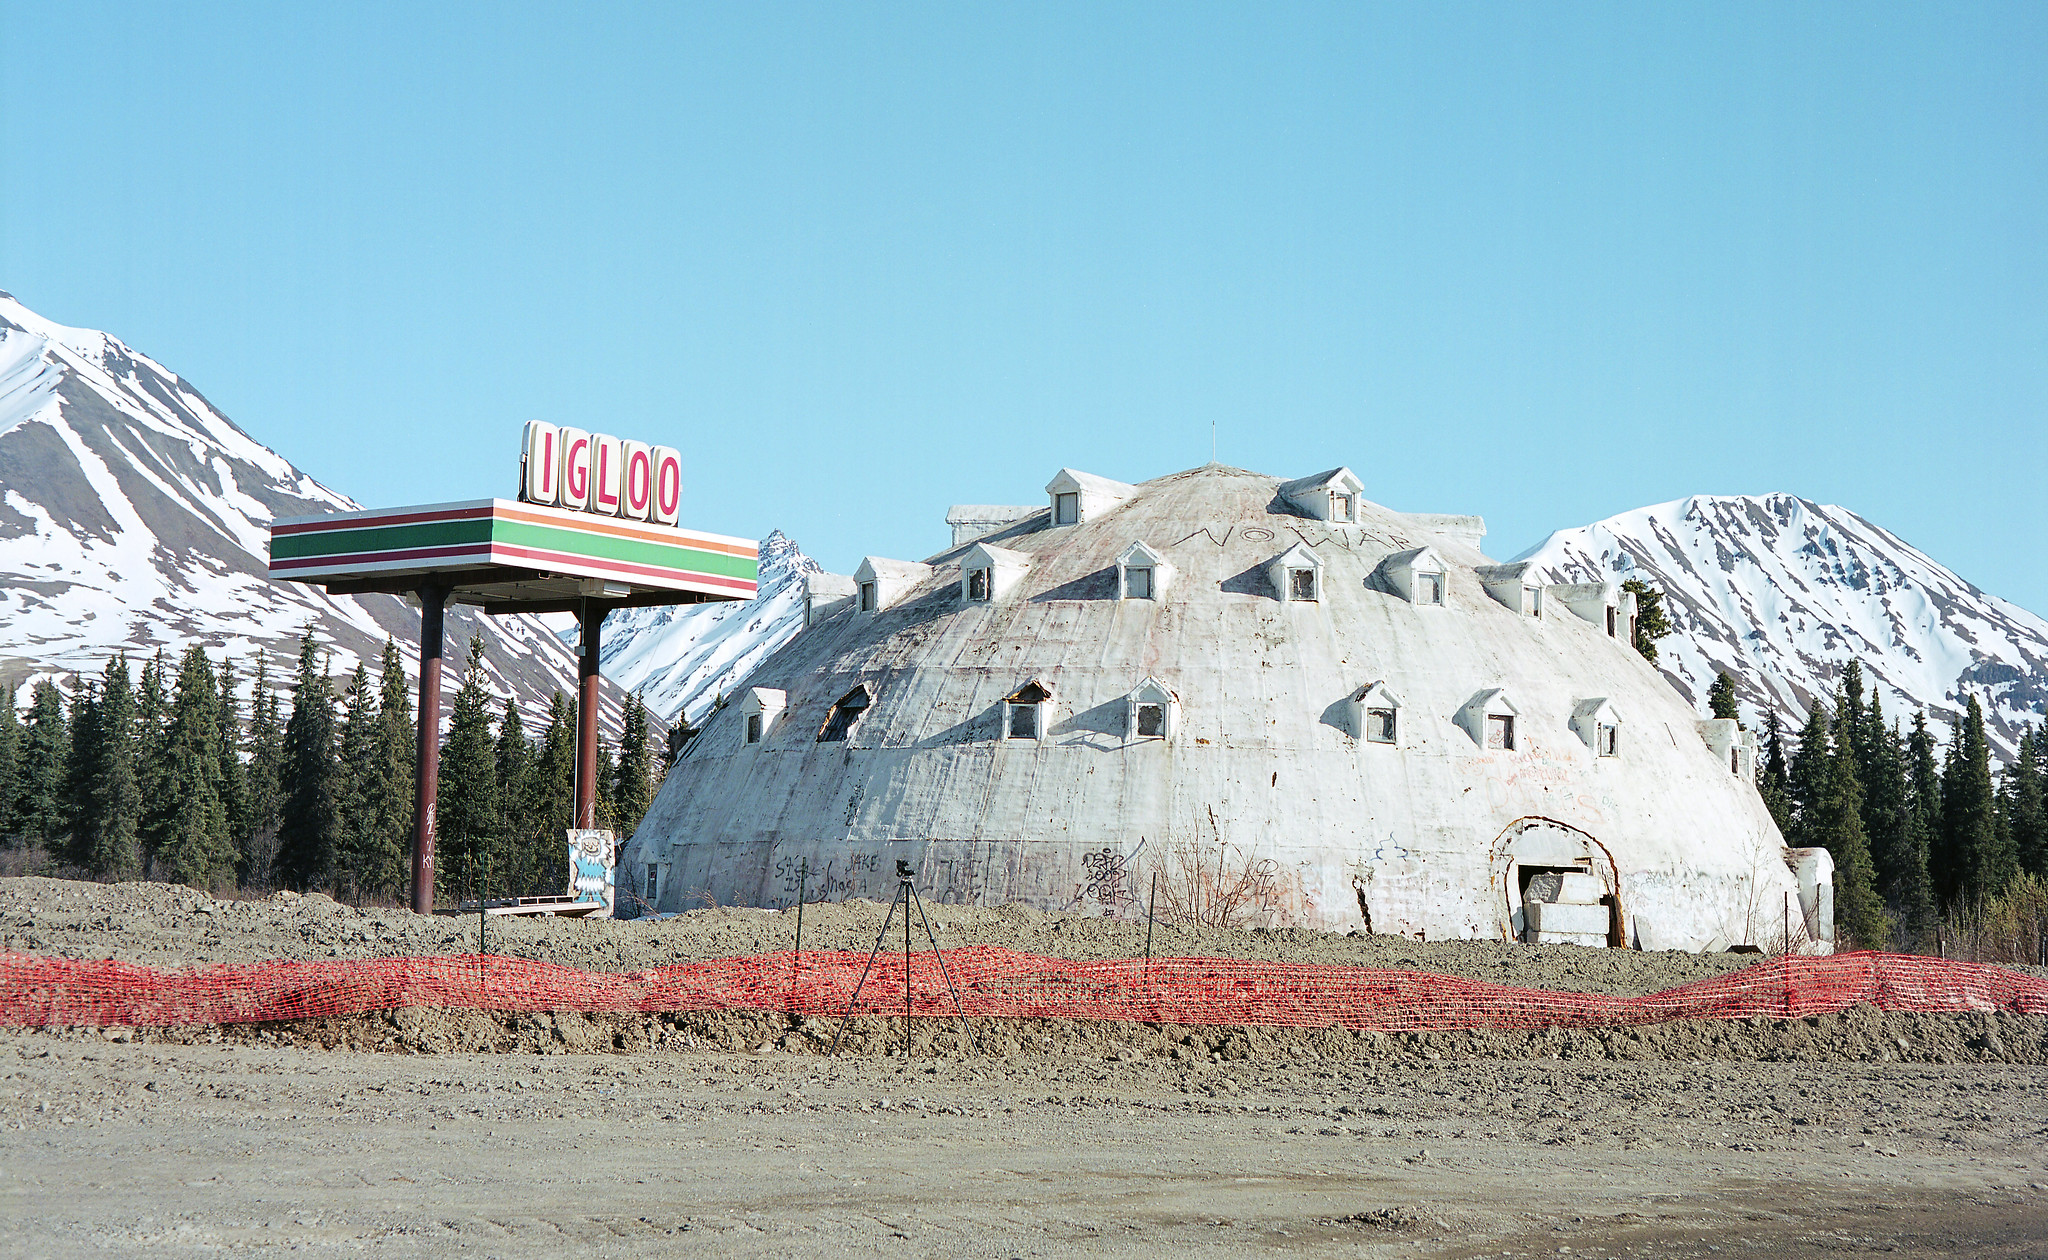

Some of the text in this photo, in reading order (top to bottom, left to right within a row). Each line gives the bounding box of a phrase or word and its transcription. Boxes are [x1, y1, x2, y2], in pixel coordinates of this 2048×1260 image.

[543, 432, 680, 516] IGLOO
[1171, 526, 1419, 550] NO WAR
